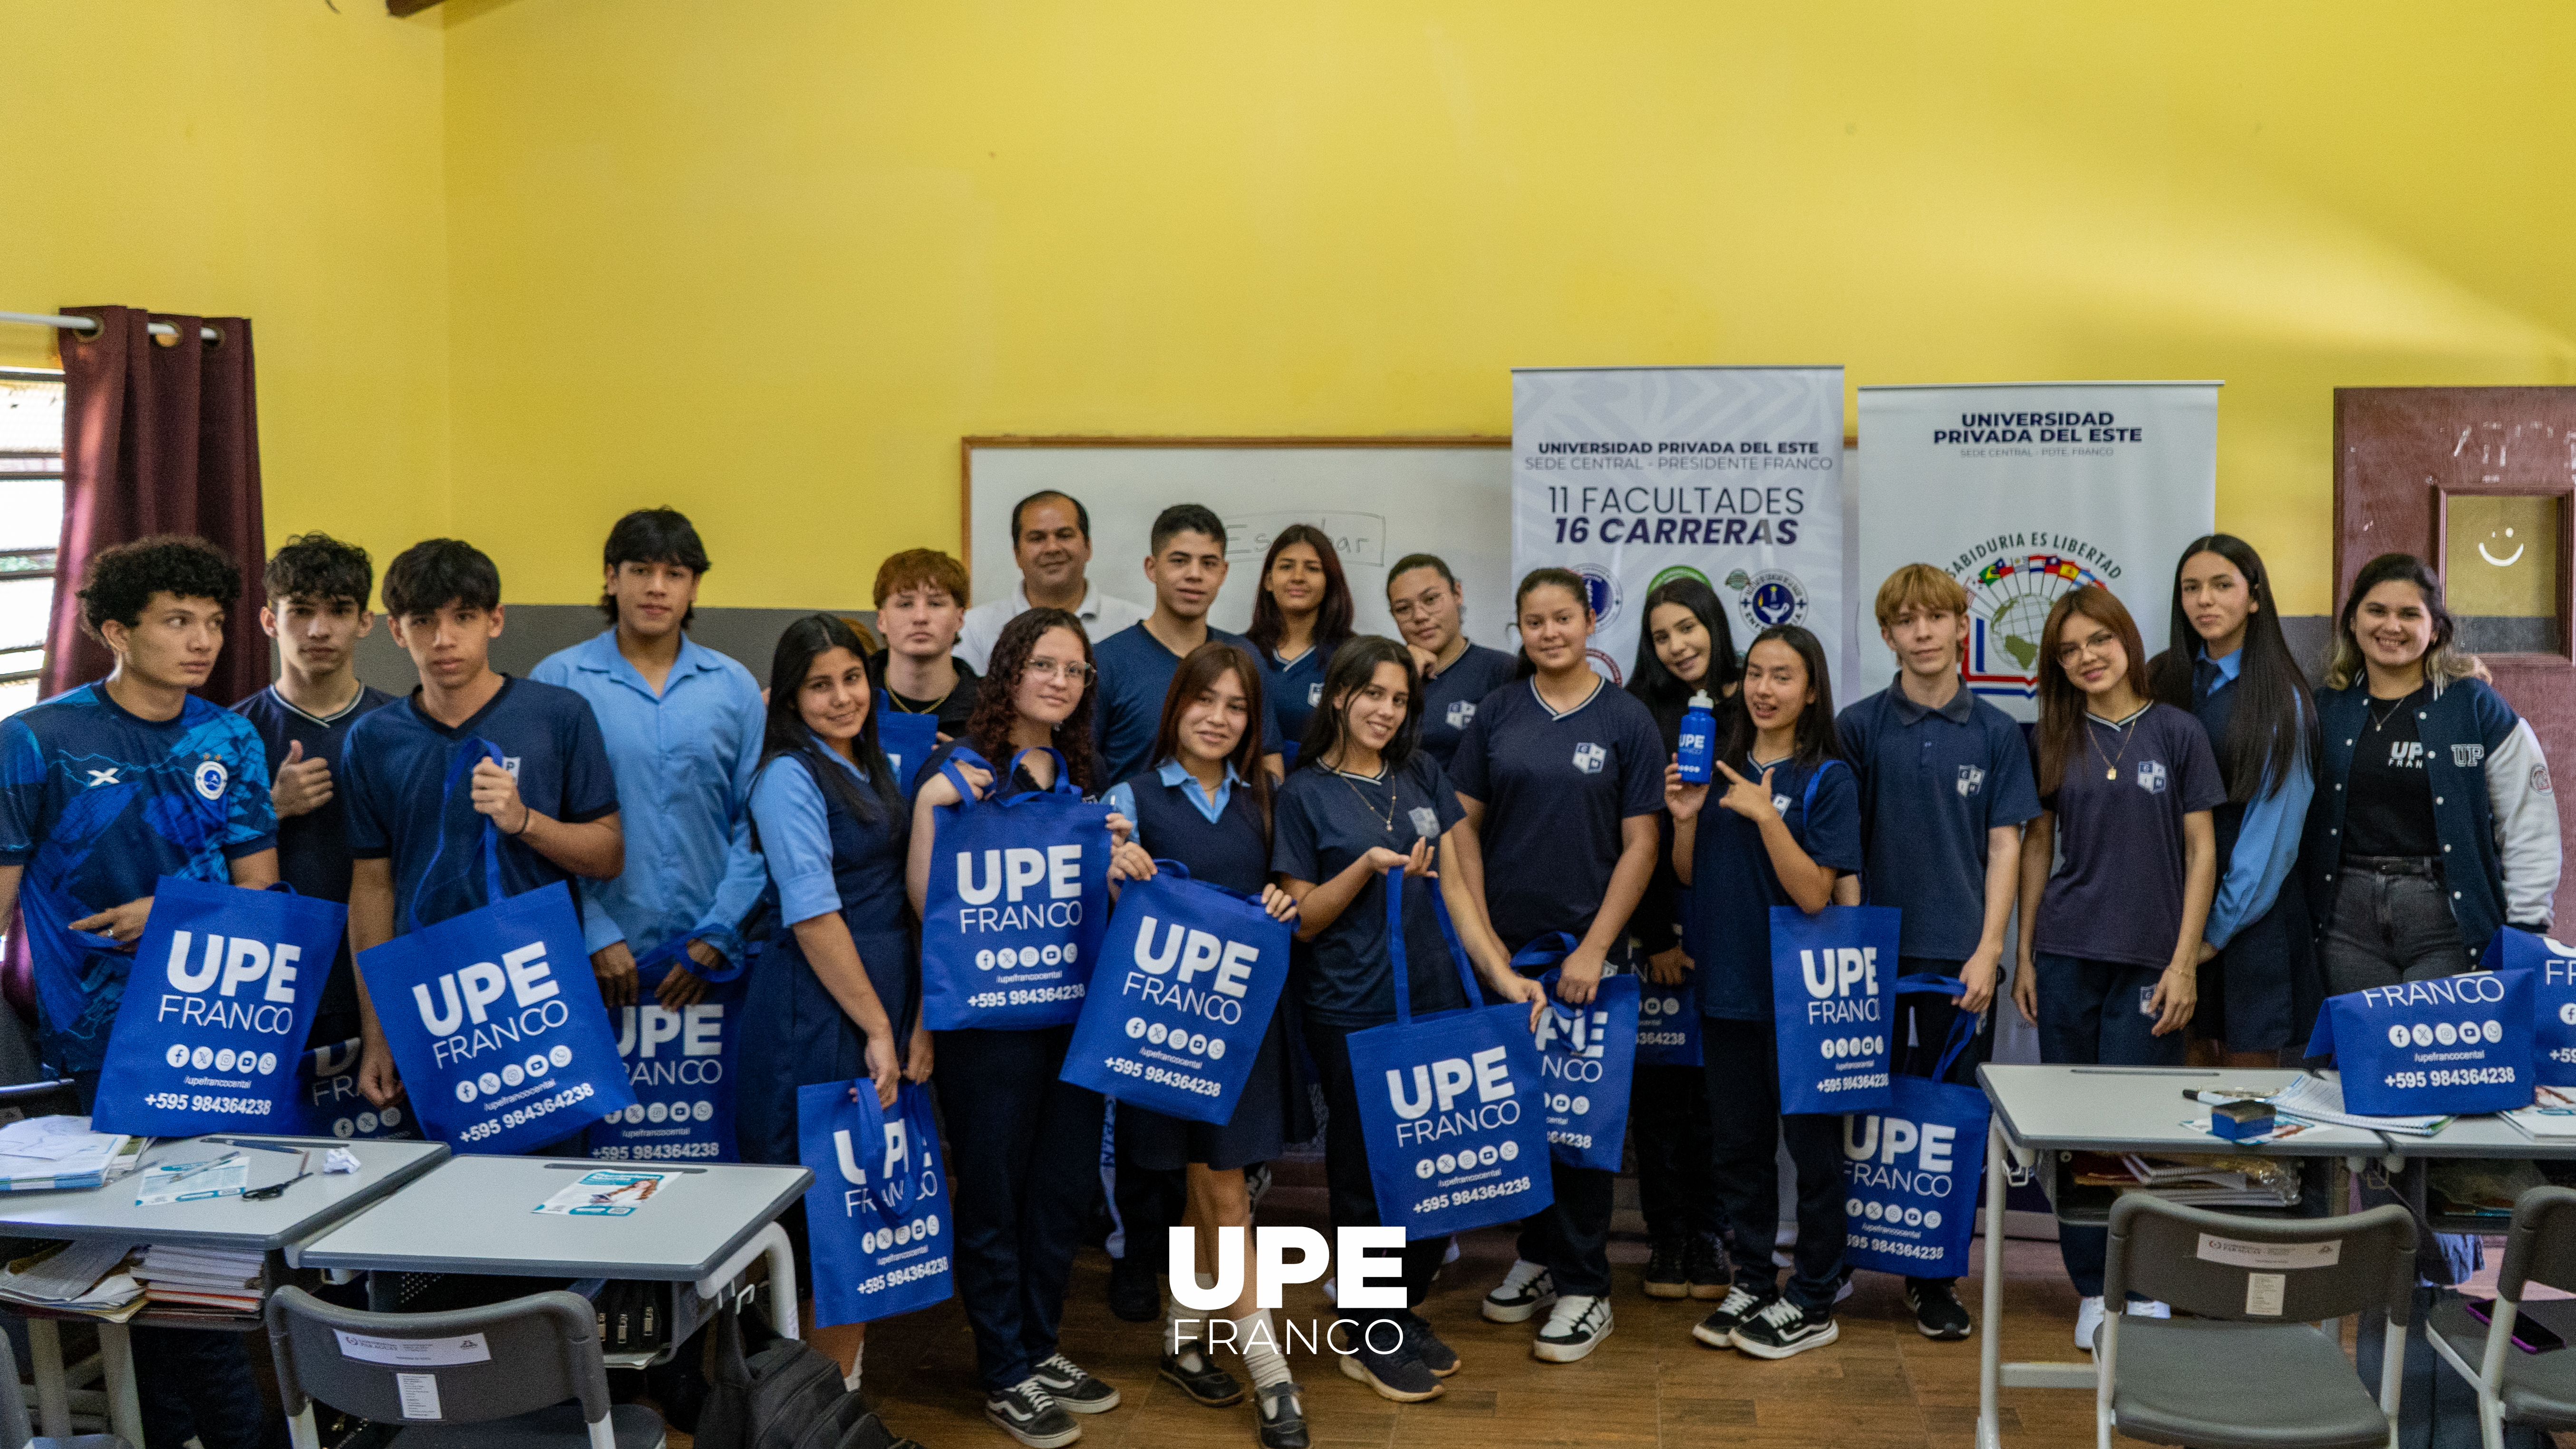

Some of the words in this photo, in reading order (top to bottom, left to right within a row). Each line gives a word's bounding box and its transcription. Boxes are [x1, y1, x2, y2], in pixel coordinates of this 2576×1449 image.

[1934, 428, 2033, 444] PRIVADA
[2040, 428, 2082, 443] DEL
[2089, 427, 2142, 442] ESTE
[1962, 411, 2114, 427] UNIVERSIDAD
[1525, 456, 1567, 471] SEDE
[1570, 456, 1644, 471] CENTRAL
[1657, 456, 1759, 471] PRESIDENTE
[1763, 455, 1833, 471] FRANCO
[1538, 442, 1653, 454] UNIVERSIDAD
[1658, 442, 1734, 454] PRIVADA
[1741, 442, 1772, 454] DEL
[1778, 442, 1819, 454] ESTE
[1960, 447, 1986, 458] SEDE
[1988, 447, 2033, 458] CENTRAL
[2072, 446, 2114, 457] FRANCO
[1548, 486, 1569, 513] 11
[1583, 486, 1804, 515] FACULTADES
[1555, 517, 1589, 544] 16
[1599, 518, 1799, 544] CARRERAS
[1947, 531, 2025, 579] SABIDURIA
[2031, 531, 2047, 547] ES
[2053, 534, 2122, 580] LIBERTAD
[1679, 733, 1705, 750] UPE
[956, 844, 1082, 906] UPE
[959, 900, 1083, 934] FRANCO
[166, 930, 301, 1004] UPE
[1133, 915, 1260, 998] UPE
[1800, 947, 1879, 999] UPE
[412, 941, 560, 1037] UPE
[967, 991, 1007, 1008] +595
[1009, 984, 1085, 1005] 984364238
[1123, 971, 1242, 1025] FRANCO
[2362, 976, 2505, 1008] FRANCO
[158, 994, 293, 1035] FRANCO
[432, 999, 568, 1070] FRANCO
[622, 1059, 723, 1086] ANCO
[1104, 1056, 1143, 1078] +595
[1144, 1065, 1221, 1098] 984364238
[1385, 1045, 1515, 1120] UPE
[1541, 1054, 1603, 1083] NCO
[2384, 1071, 2427, 1089] +595
[2430, 1066, 2516, 1087] 984364238
[145, 1092, 189, 1111] +595
[191, 1094, 272, 1116] 984364238
[459, 1120, 502, 1143] +595
[502, 1082, 595, 1129] 984364238
[1395, 1099, 1521, 1148] FRANCO
[632, 1142, 719, 1159] 984364238
[1844, 1114, 1956, 1173] UPE
[1412, 1193, 1450, 1215] +595
[1451, 1176, 1531, 1208] 984364238
[857, 1275, 885, 1294] +595
[886, 1256, 949, 1287] 984364238
